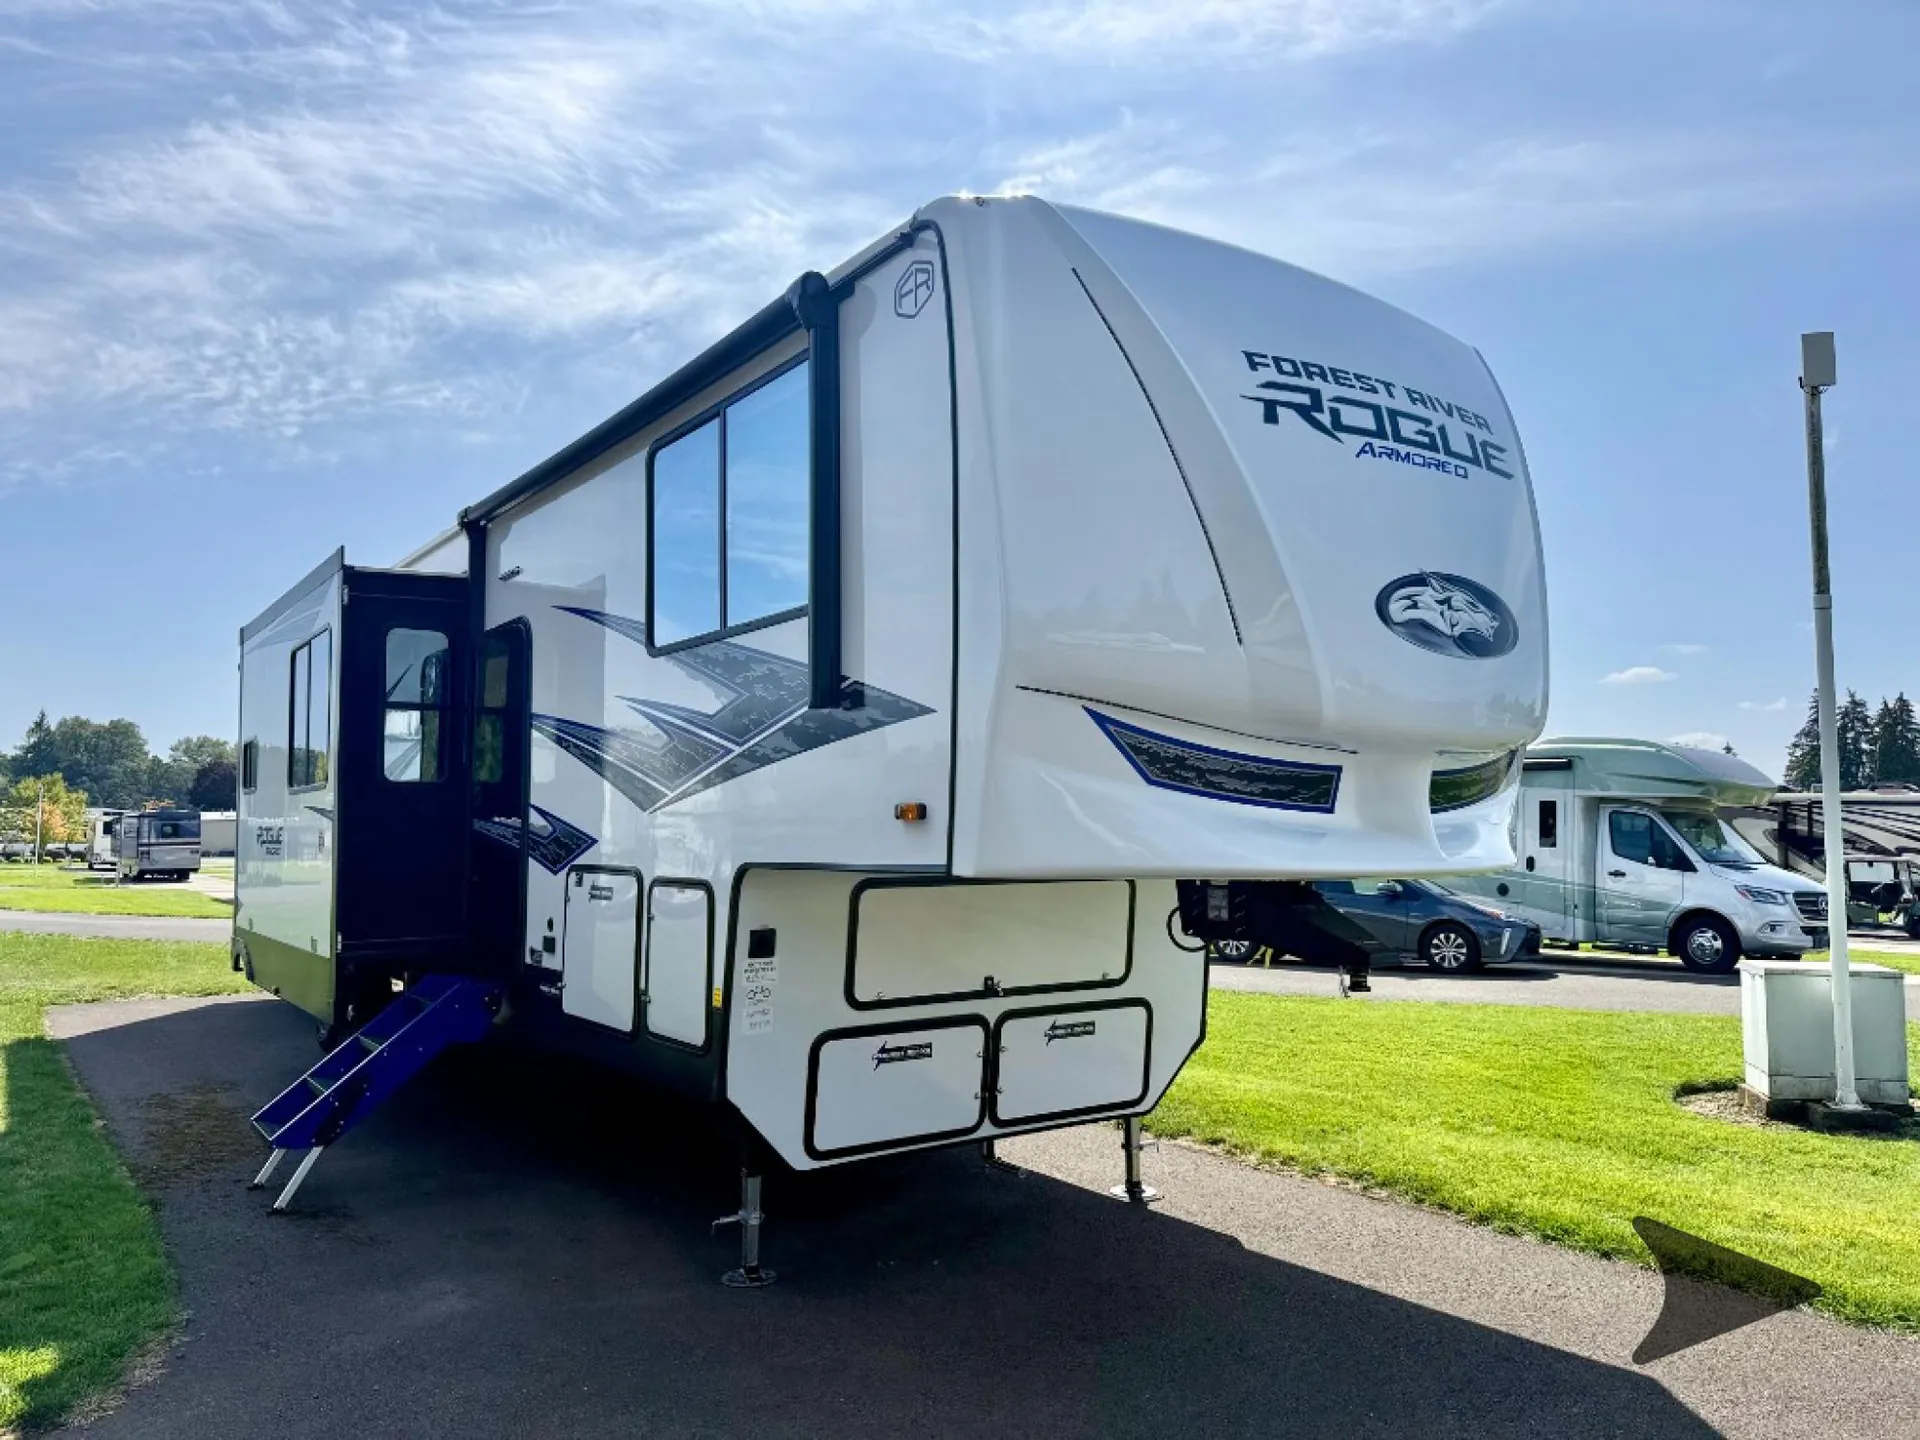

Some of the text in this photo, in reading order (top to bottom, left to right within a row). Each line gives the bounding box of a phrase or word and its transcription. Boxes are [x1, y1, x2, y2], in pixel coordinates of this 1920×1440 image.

[1239, 380, 1515, 481] ROGUE
[1241, 350, 1494, 436] FOREST RIVER
[1355, 441, 1469, 480] ARMORED
